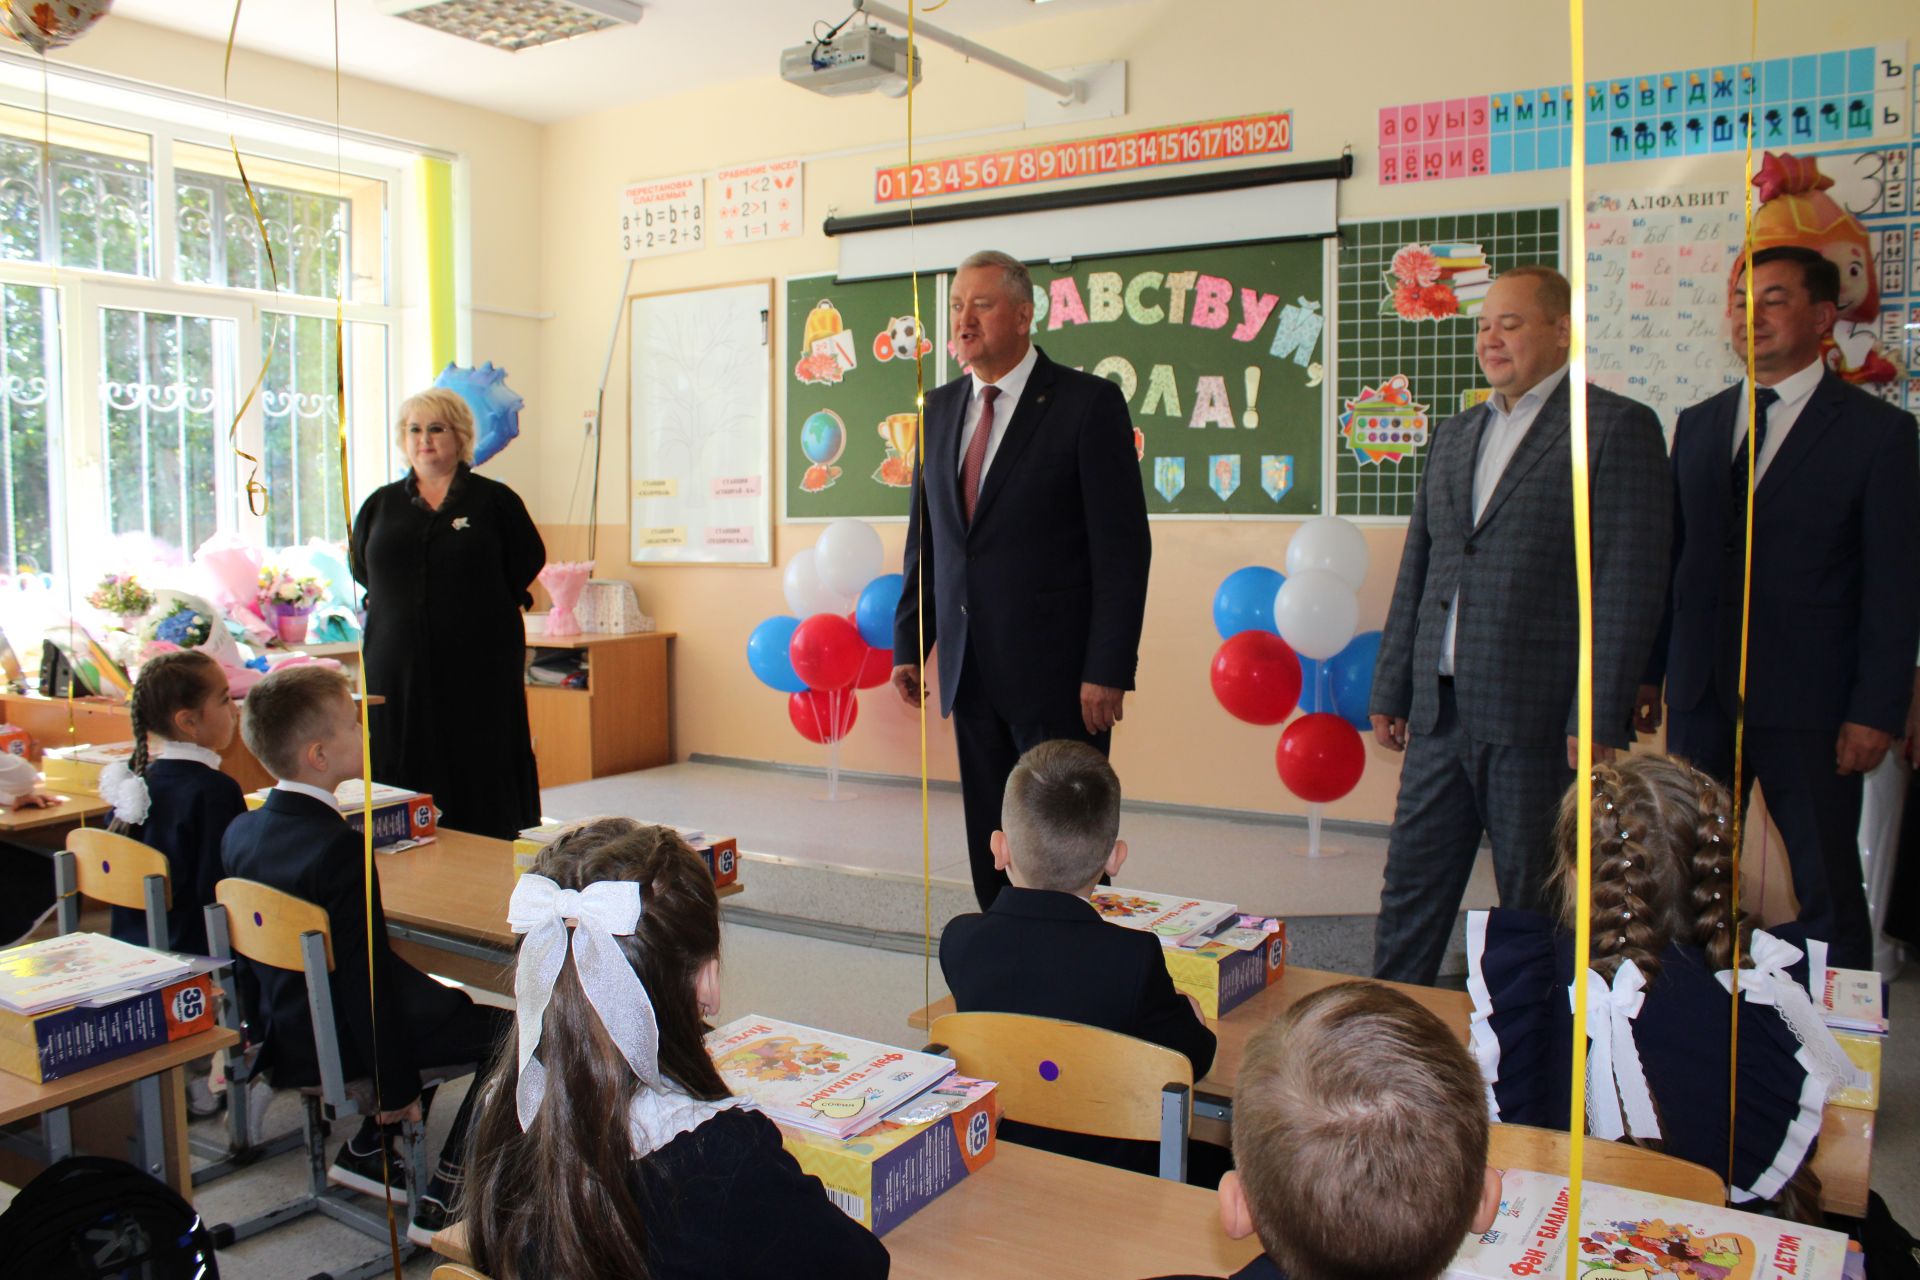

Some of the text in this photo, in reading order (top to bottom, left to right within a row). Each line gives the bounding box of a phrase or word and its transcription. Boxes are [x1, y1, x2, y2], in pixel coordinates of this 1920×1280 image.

[897, 172, 907, 196] 1
[911, 169, 924, 194] 2
[927, 166, 942, 192] 3
[945, 163, 960, 189] 4
[964, 161, 979, 186] 5
[982, 158, 998, 184] 6
[1001, 156, 1015, 182] 7
[1019, 153, 1035, 179] 8
[1040, 150, 1055, 177] 9
[1058, 147, 1077, 175] 10
[1079, 145, 1096, 171] 11
[1098, 142, 1117, 169] 12
[1118, 139, 1137, 166] 13
[1138, 136, 1157, 164] 14
[1159, 133, 1179, 160] 15
[1180, 130, 1200, 158] 16
[1201, 128, 1222, 156] 17
[1224, 124, 1244, 153] 18
[1245, 122, 1267, 150] 19
[1267, 119, 1289, 148] 20
[625, 180, 693, 197] ПЕРЕСТАНОВКА
[1627, 191, 1729, 211] АЛФАВИТ
[1073, 356, 1262, 430] ОЛА!
[182, 988, 204, 1019] 35
[975, 1114, 989, 1150] 35
[1536, 1186, 1570, 1240] БАЛАЛАРГ
